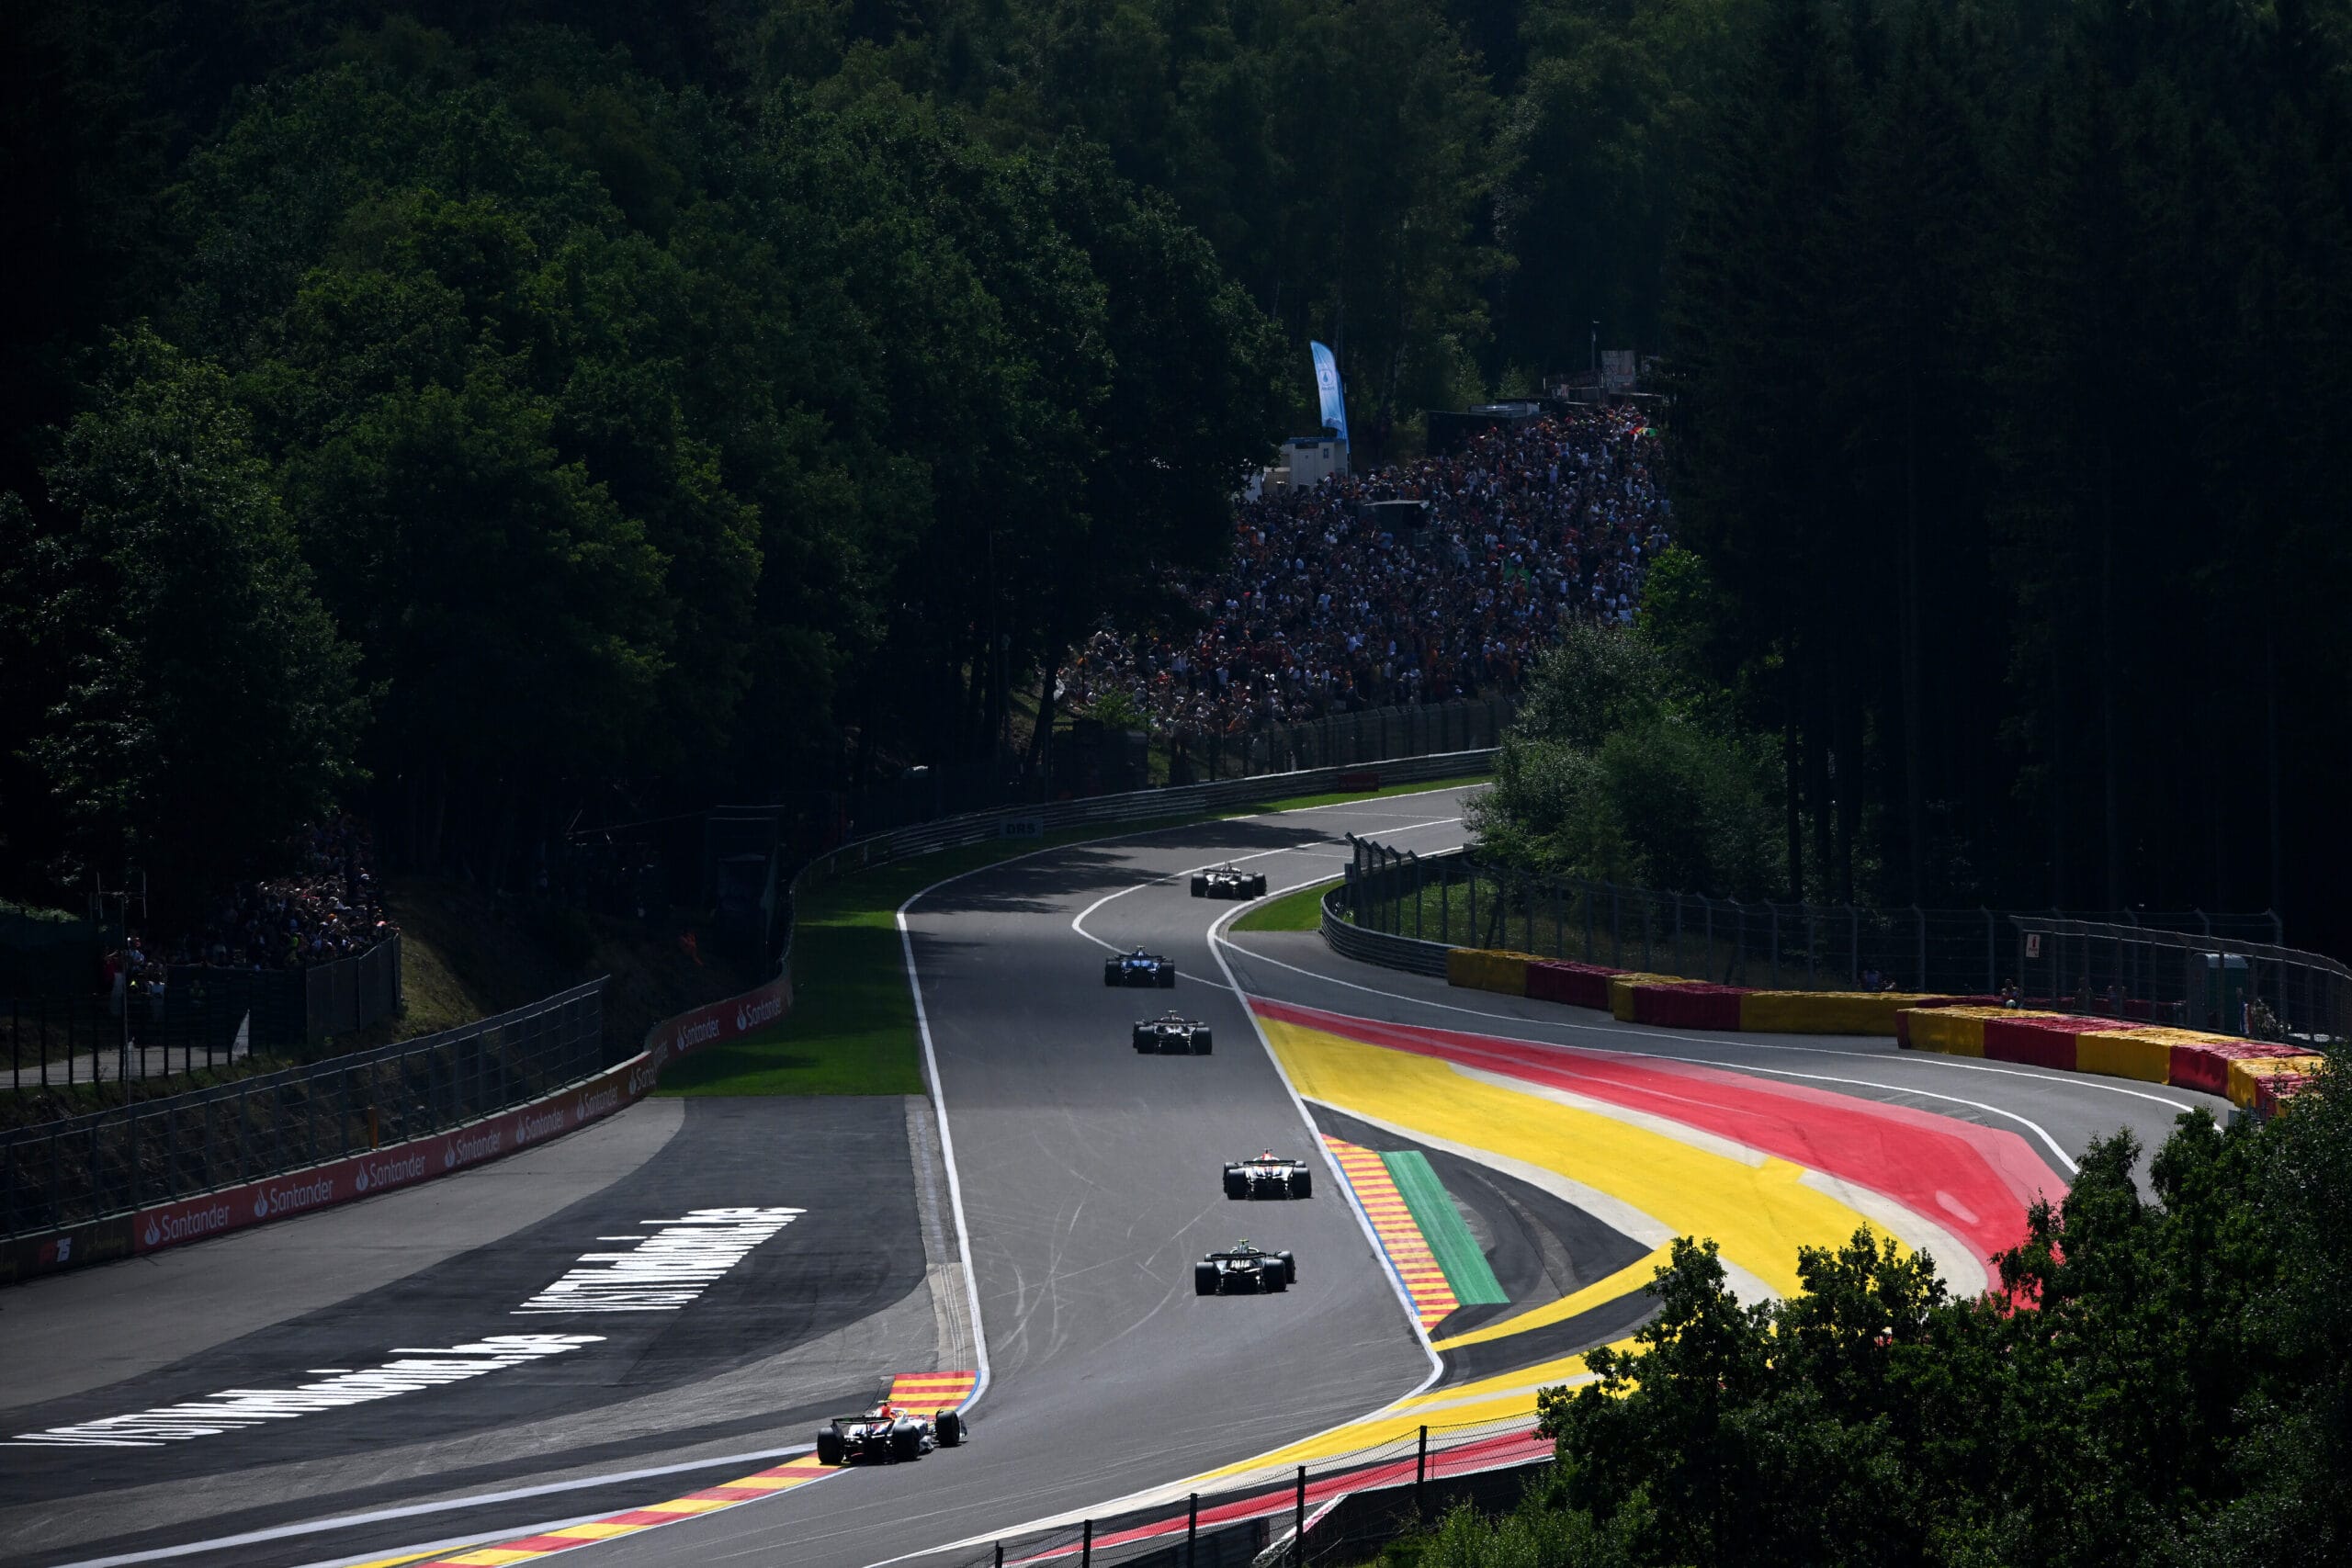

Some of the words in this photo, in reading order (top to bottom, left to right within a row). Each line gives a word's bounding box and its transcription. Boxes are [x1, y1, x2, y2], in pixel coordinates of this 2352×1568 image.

[1006, 822, 1035, 834] DRS
[683, 1019, 720, 1047] Santander
[584, 1085, 619, 1117] Santander
[525, 1108, 564, 1140] Santander
[456, 1129, 502, 1164] Santander
[369, 1154, 426, 1187] Santander
[270, 1178, 334, 1213] Santander
[162, 1204, 231, 1241] Santander
